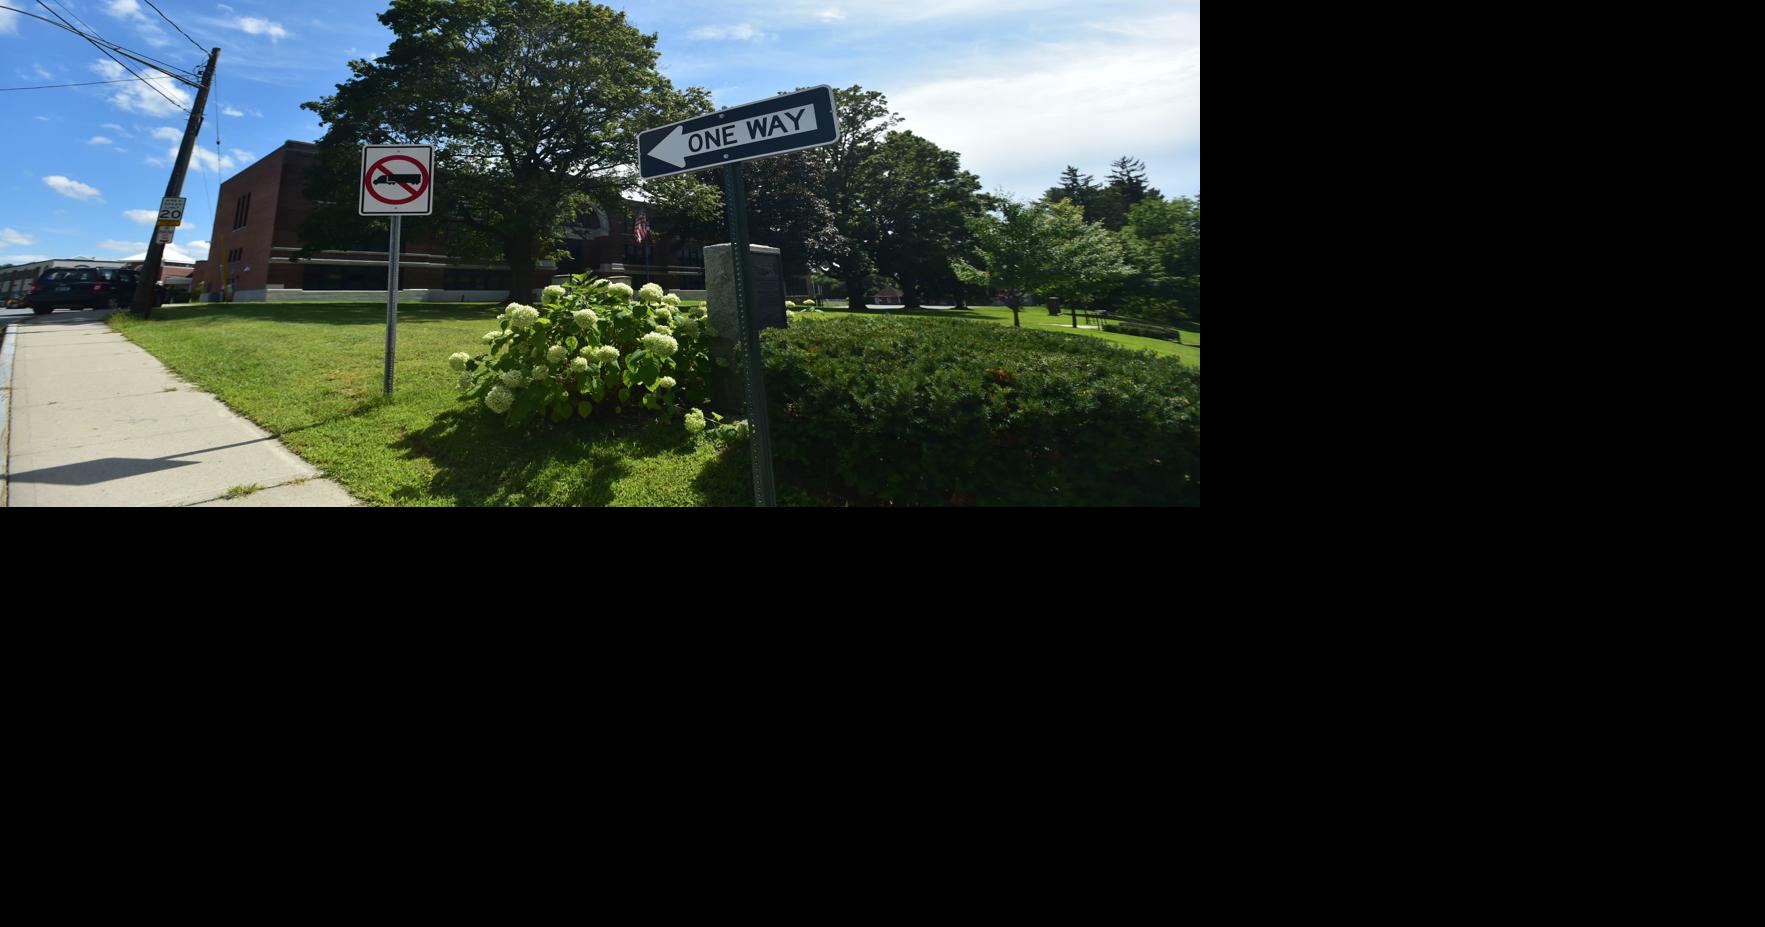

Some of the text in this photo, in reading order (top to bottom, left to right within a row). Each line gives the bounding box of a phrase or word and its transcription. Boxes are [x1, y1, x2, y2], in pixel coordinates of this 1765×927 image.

[688, 108, 806, 152] ONE WAY
[160, 209, 182, 219] 20
